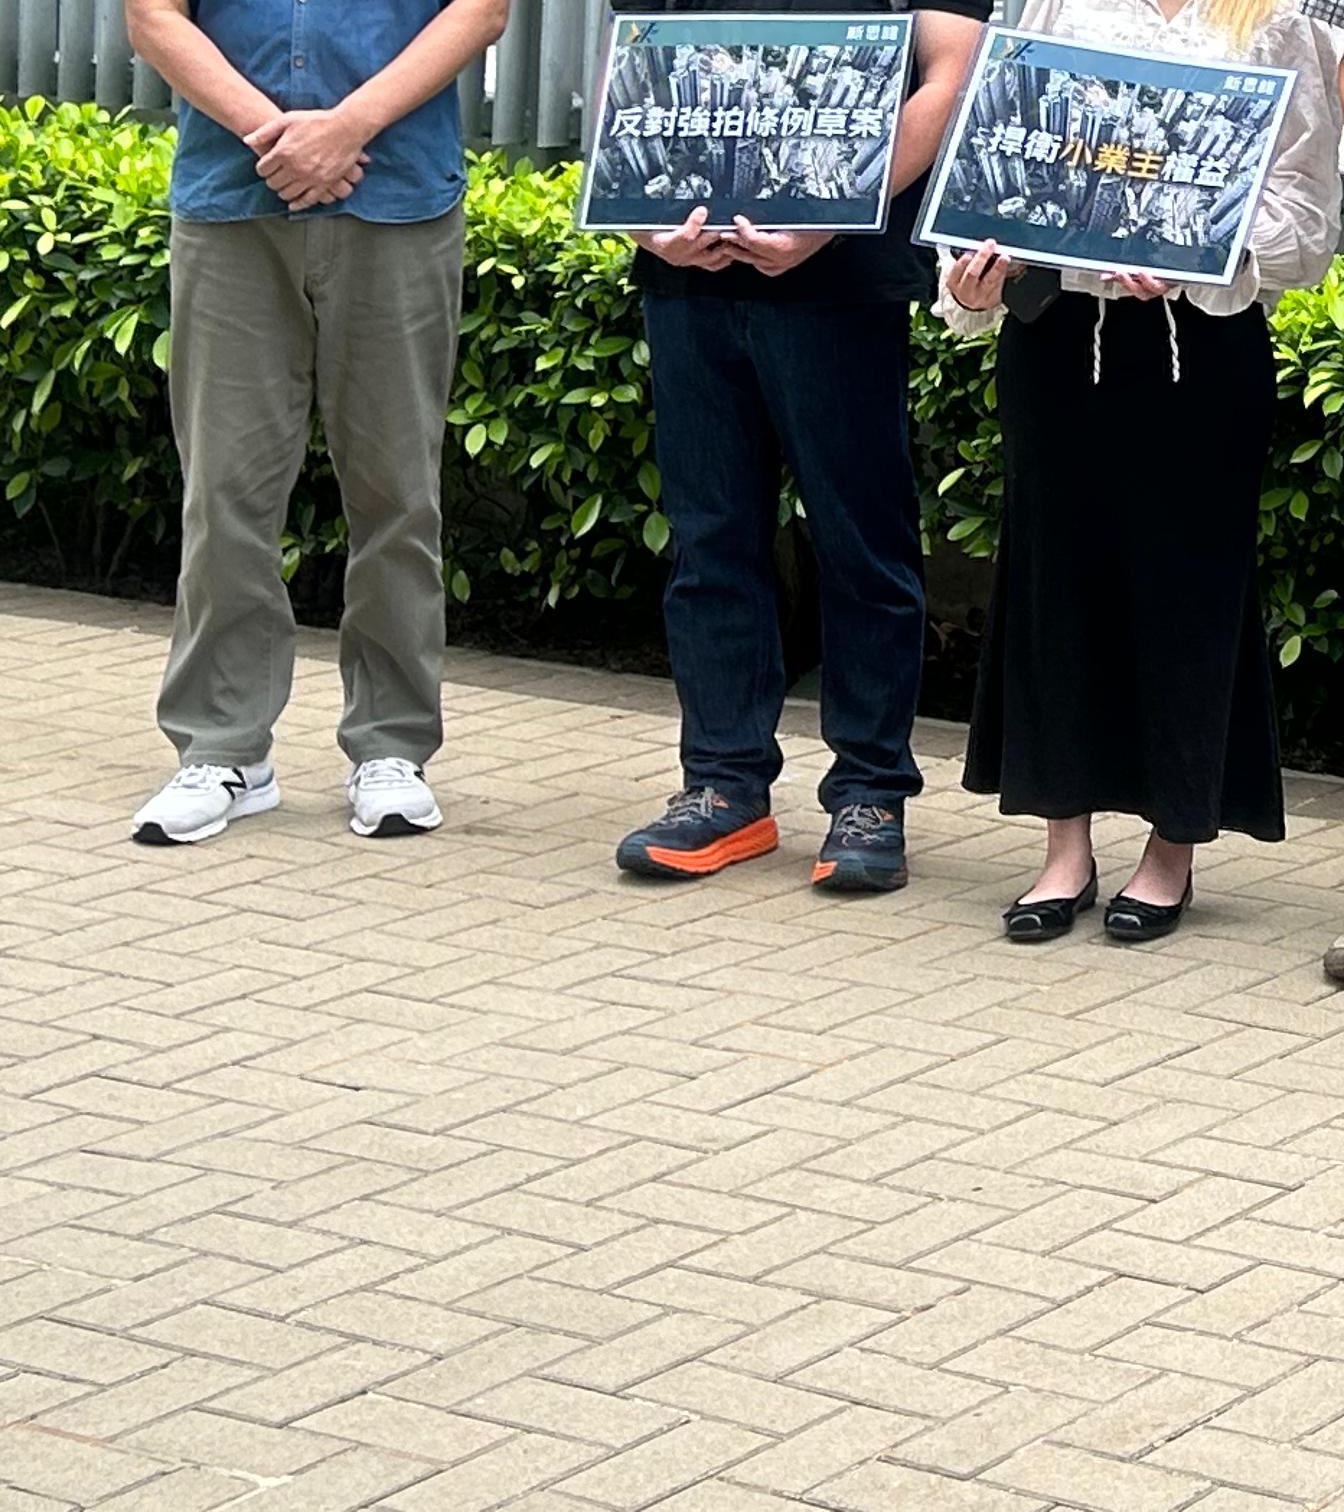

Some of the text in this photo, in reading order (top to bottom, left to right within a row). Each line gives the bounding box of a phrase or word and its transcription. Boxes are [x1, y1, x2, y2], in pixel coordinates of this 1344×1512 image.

[610, 105, 883, 138] 反對強拍條例草案
[988, 122, 1232, 189] 捍衛小業主權益
